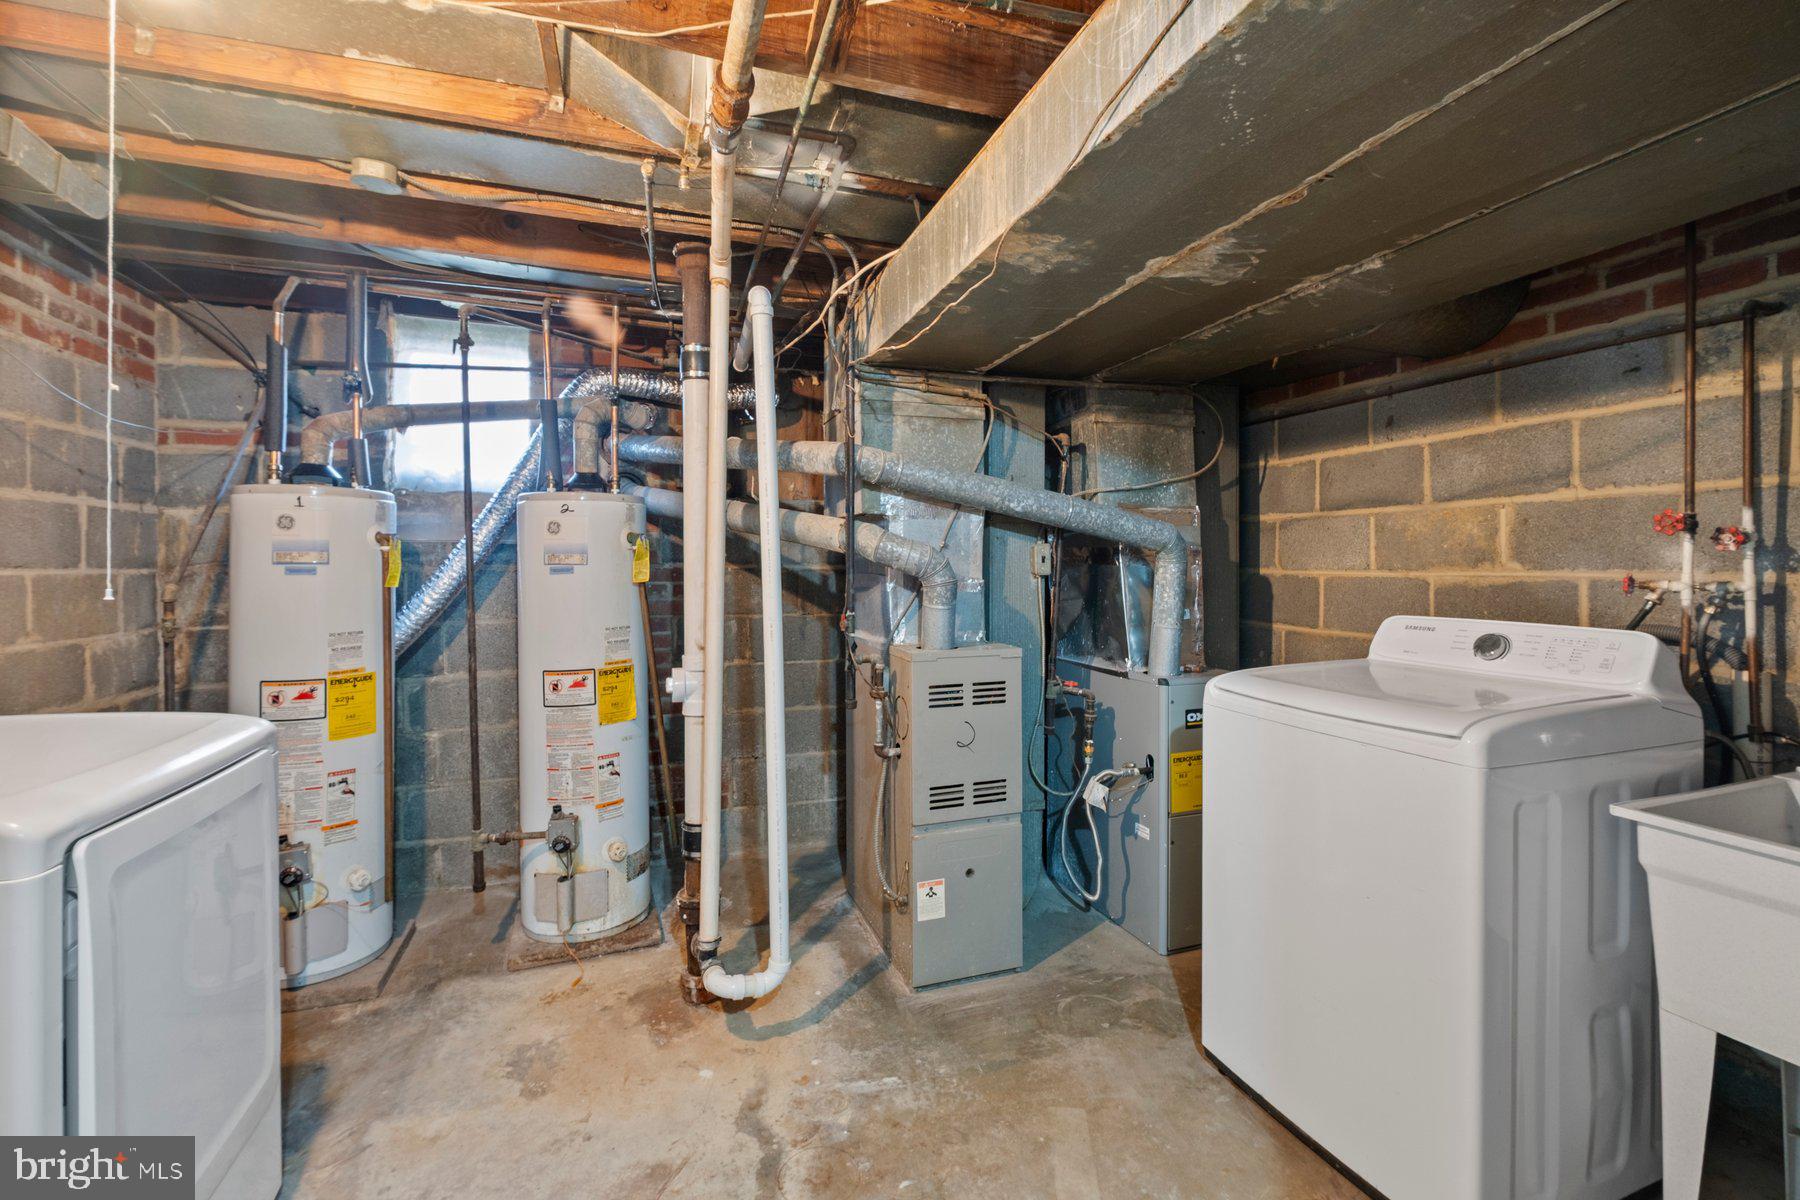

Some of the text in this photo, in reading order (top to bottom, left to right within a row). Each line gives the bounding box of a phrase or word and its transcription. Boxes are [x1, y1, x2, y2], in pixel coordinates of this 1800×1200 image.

[294, 496, 305, 508] 1
[560, 503, 575, 514] 2
[1405, 624, 1437, 632] SAMSUNG
